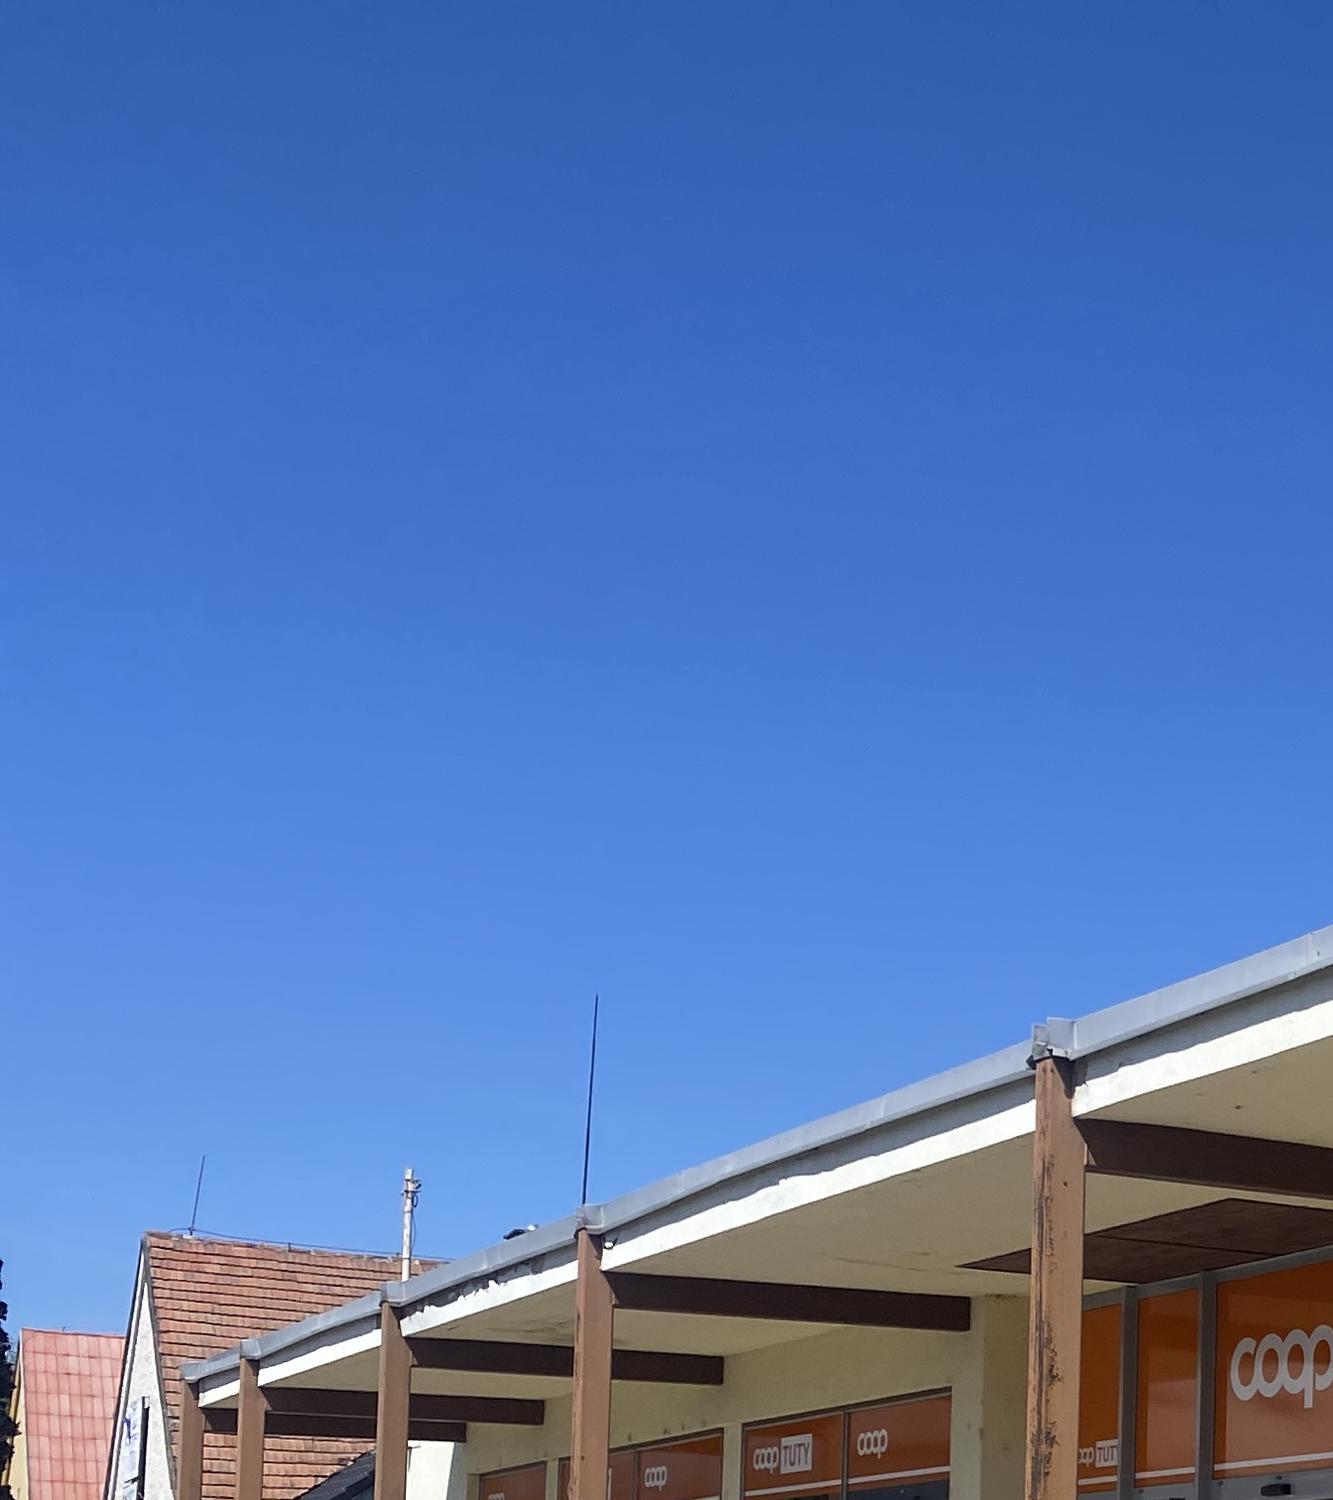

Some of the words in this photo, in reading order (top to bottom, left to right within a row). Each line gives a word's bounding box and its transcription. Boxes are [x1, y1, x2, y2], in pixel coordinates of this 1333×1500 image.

[753, 1447, 779, 1474] coop
[783, 1442, 810, 1467] TUTY
[857, 1429, 888, 1459] coop
[644, 1466, 667, 1491] coop
